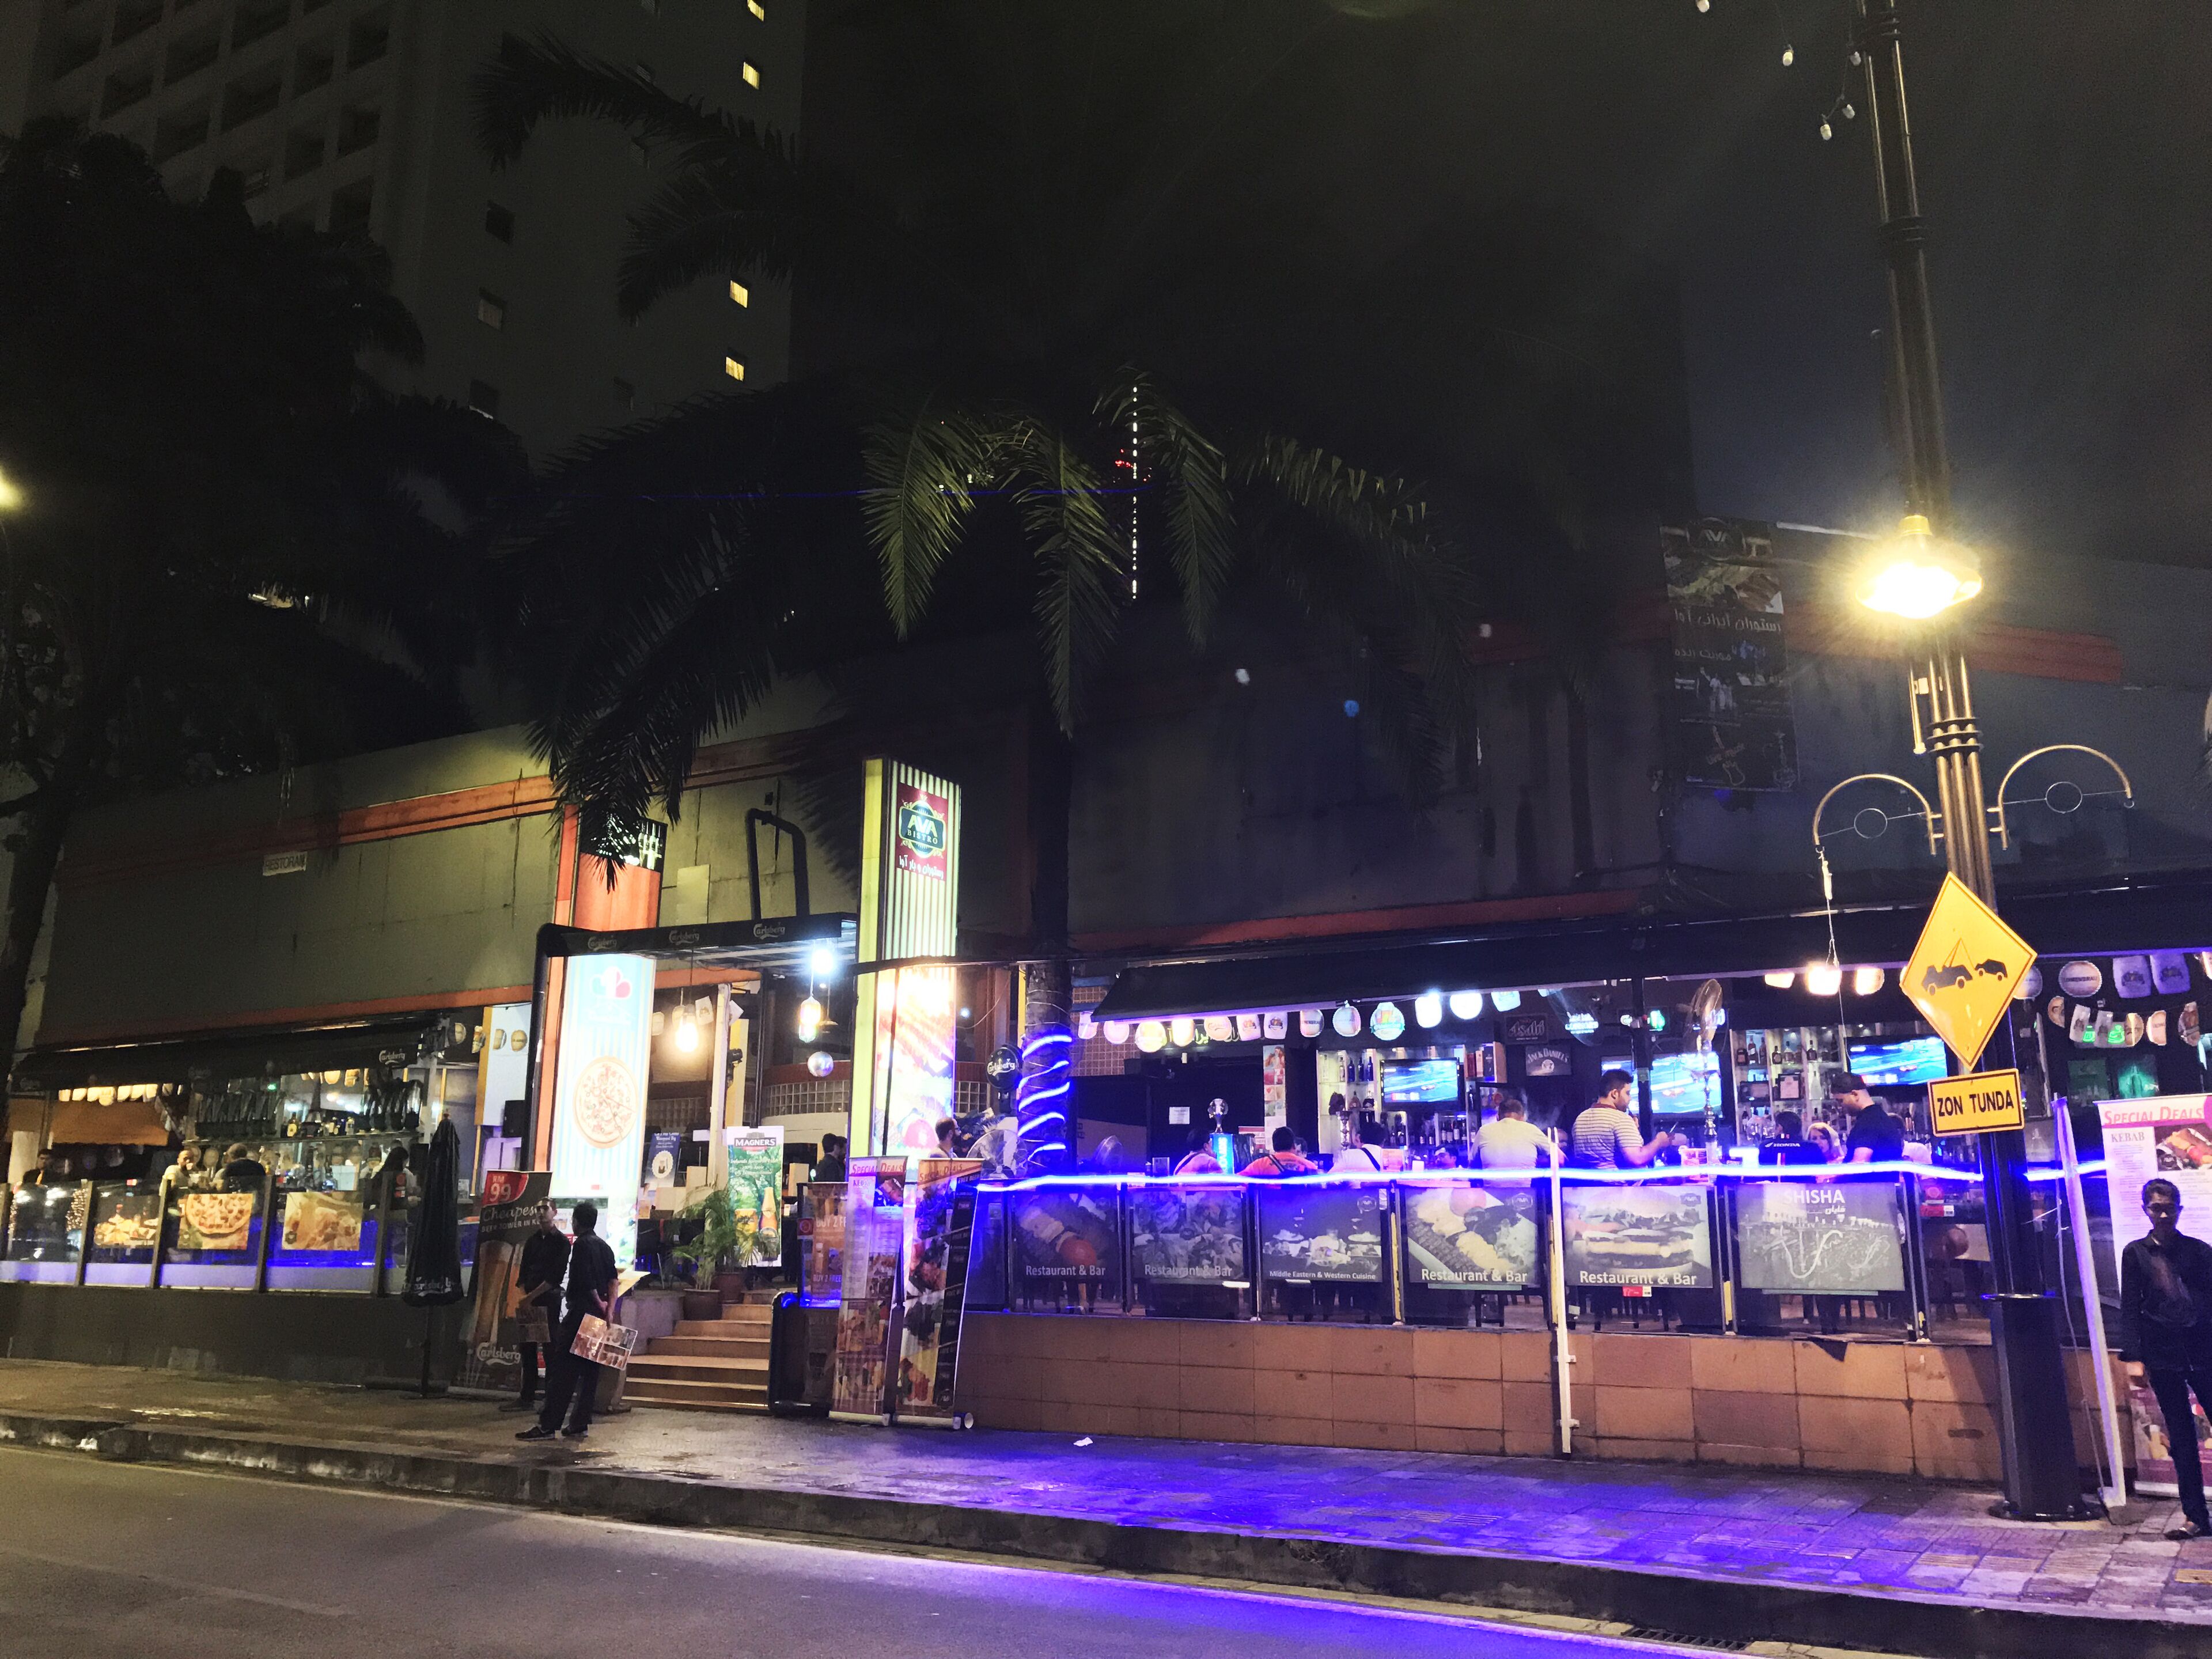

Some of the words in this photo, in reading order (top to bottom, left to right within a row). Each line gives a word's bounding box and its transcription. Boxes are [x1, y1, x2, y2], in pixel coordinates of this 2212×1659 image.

[907, 814, 938, 838] AVA
[907, 829, 938, 845] BISTRO
[669, 929, 699, 945] Carlsberg
[753, 923, 785, 940] Carlsberg
[1937, 1096, 1964, 1116] ZON
[1969, 1090, 2014, 1113] TUNDA
[2104, 1111, 2154, 1124] SPECIAL
[2160, 1106, 2203, 1121] DEALS
[734, 1138, 776, 1147] MAGNERS
[2111, 1131, 2145, 1143] KEBAB
[880, 1162, 903, 1173] DEALS
[493, 1175, 505, 1183] RM
[490, 1183, 512, 1202] 99
[1784, 1189, 1846, 1204] SHISHA
[816, 1216, 831, 1228] BUY
[833, 1216, 839, 1228] 2
[1025, 1265, 1077, 1277] Restaurant
[1079, 1265, 1088, 1276] &
[1089, 1266, 1106, 1277] Bar
[1145, 1264, 1199, 1277] Restaurant
[1203, 1265, 1211, 1276] &
[1214, 1265, 1233, 1277] Bar
[1269, 1270, 1291, 1278] Middle
[1421, 1268, 1488, 1282] Restaurant
[1491, 1270, 1503, 1282] &
[1506, 1270, 1528, 1282] Bar
[813, 1274, 823, 1282] BUY
[823, 1274, 828, 1282] 2
[1580, 1270, 1654, 1285] Restaurant
[1658, 1271, 1670, 1285] &
[1673, 1272, 1697, 1286] Bar
[476, 1343, 521, 1365] Carlsberg
